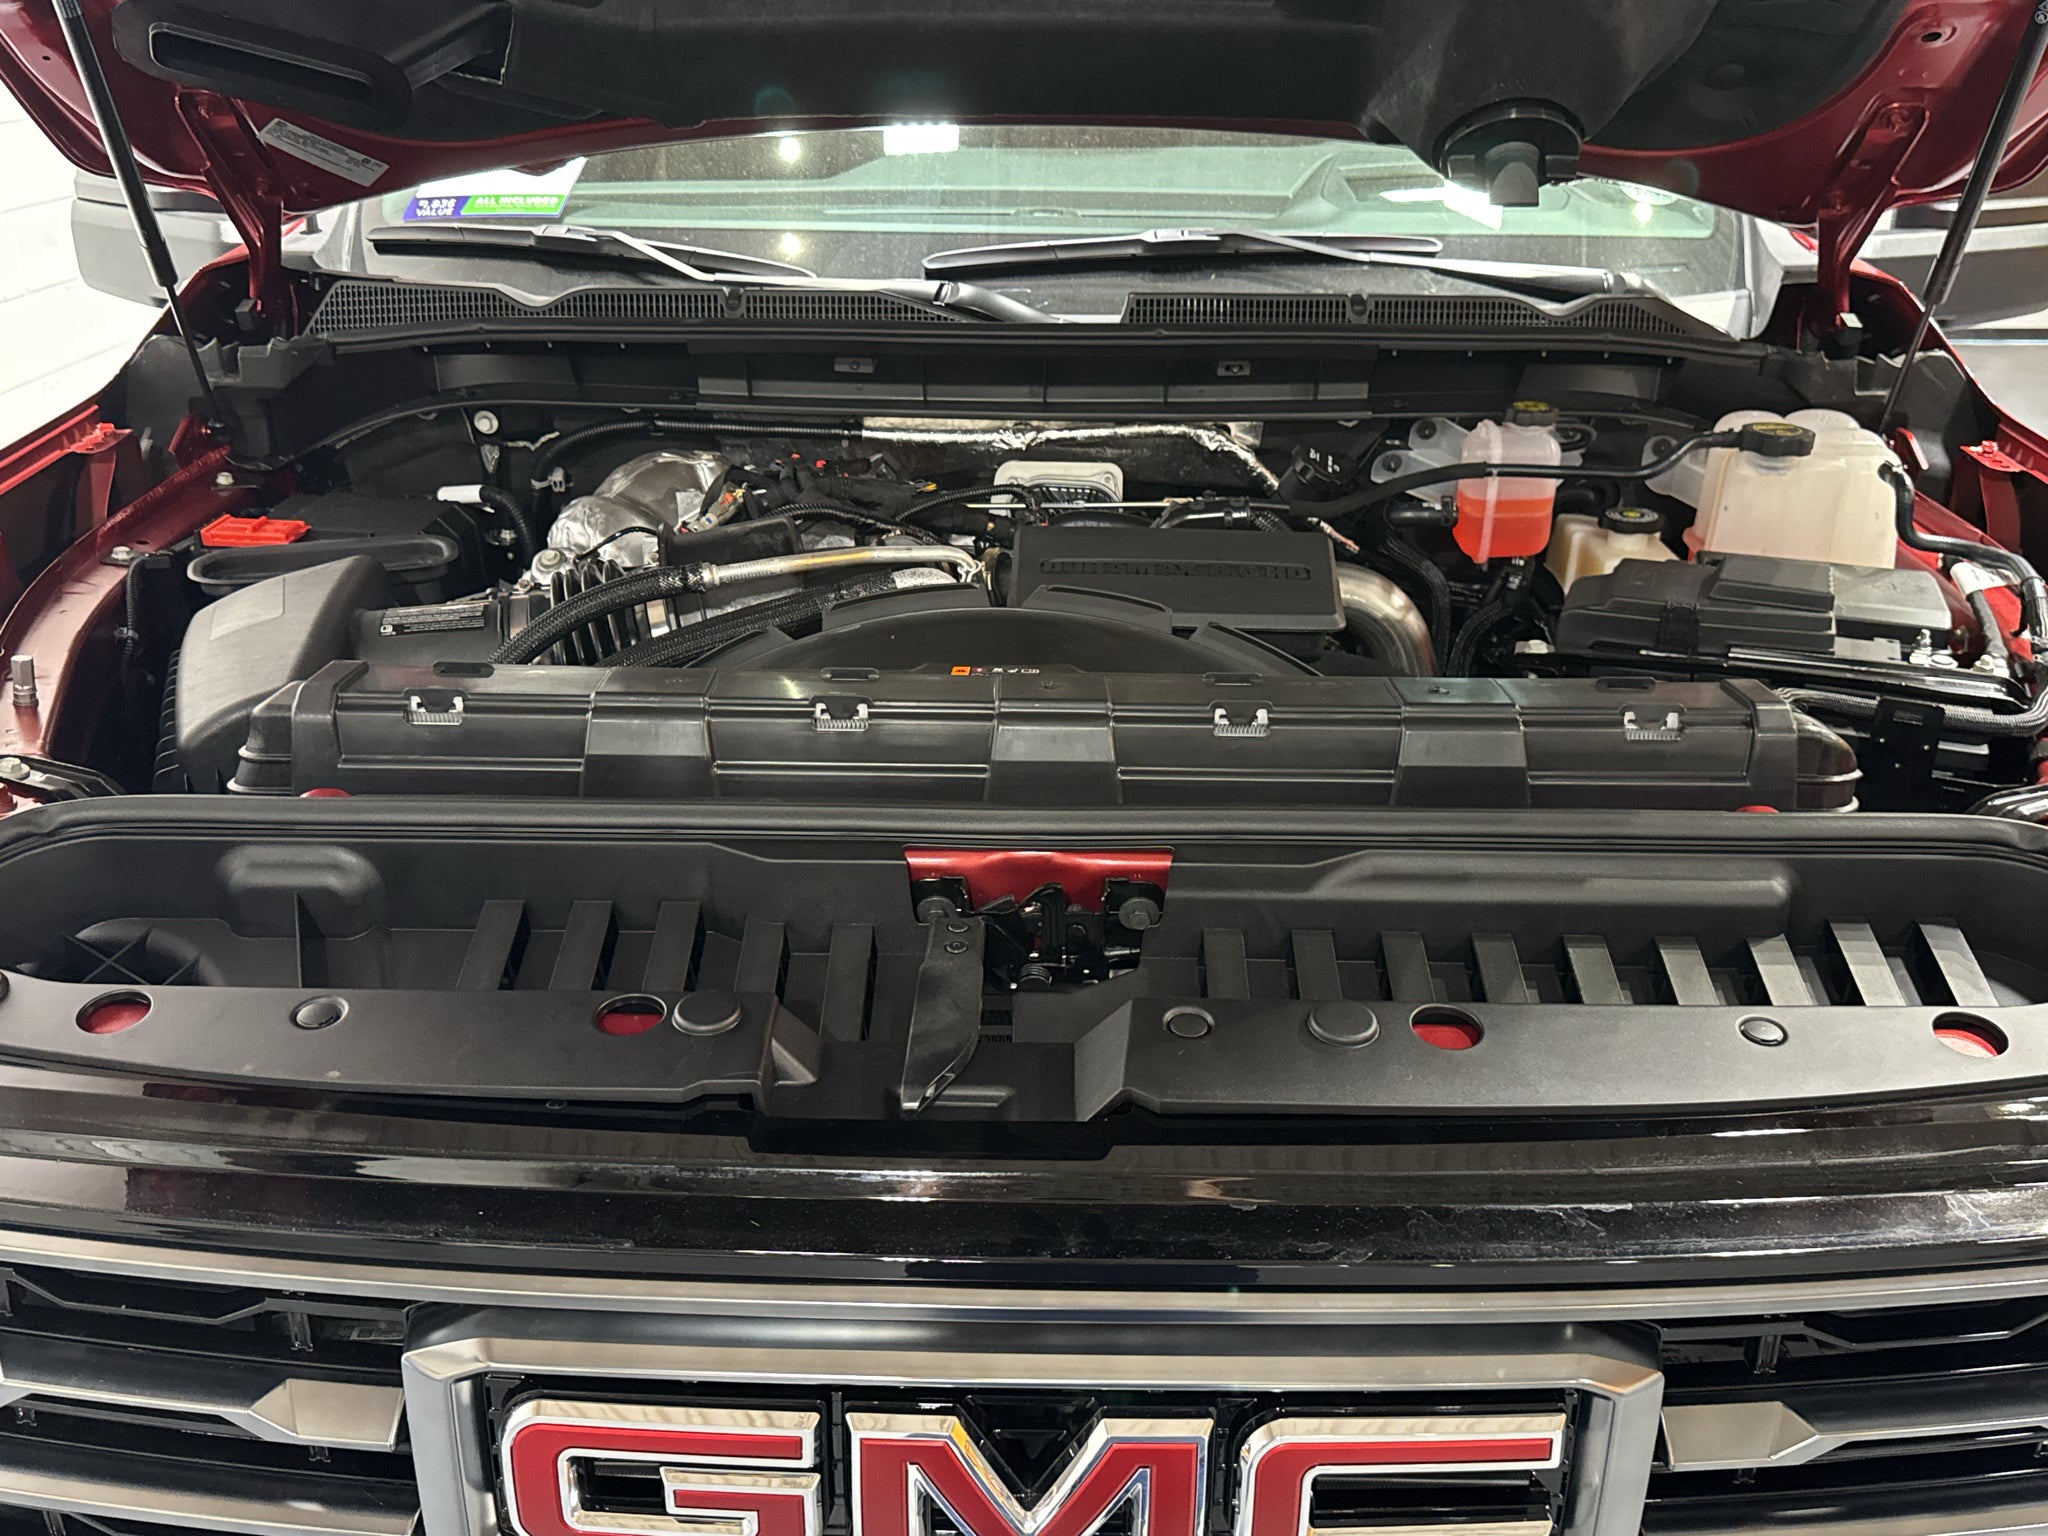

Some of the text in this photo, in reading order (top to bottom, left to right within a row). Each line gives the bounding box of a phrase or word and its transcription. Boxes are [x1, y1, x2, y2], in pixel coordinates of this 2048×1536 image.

[474, 196, 559, 205] ALL INCLUDED
[416, 207, 455, 217] VALUE
[499, 1398, 1566, 1536] GMC
